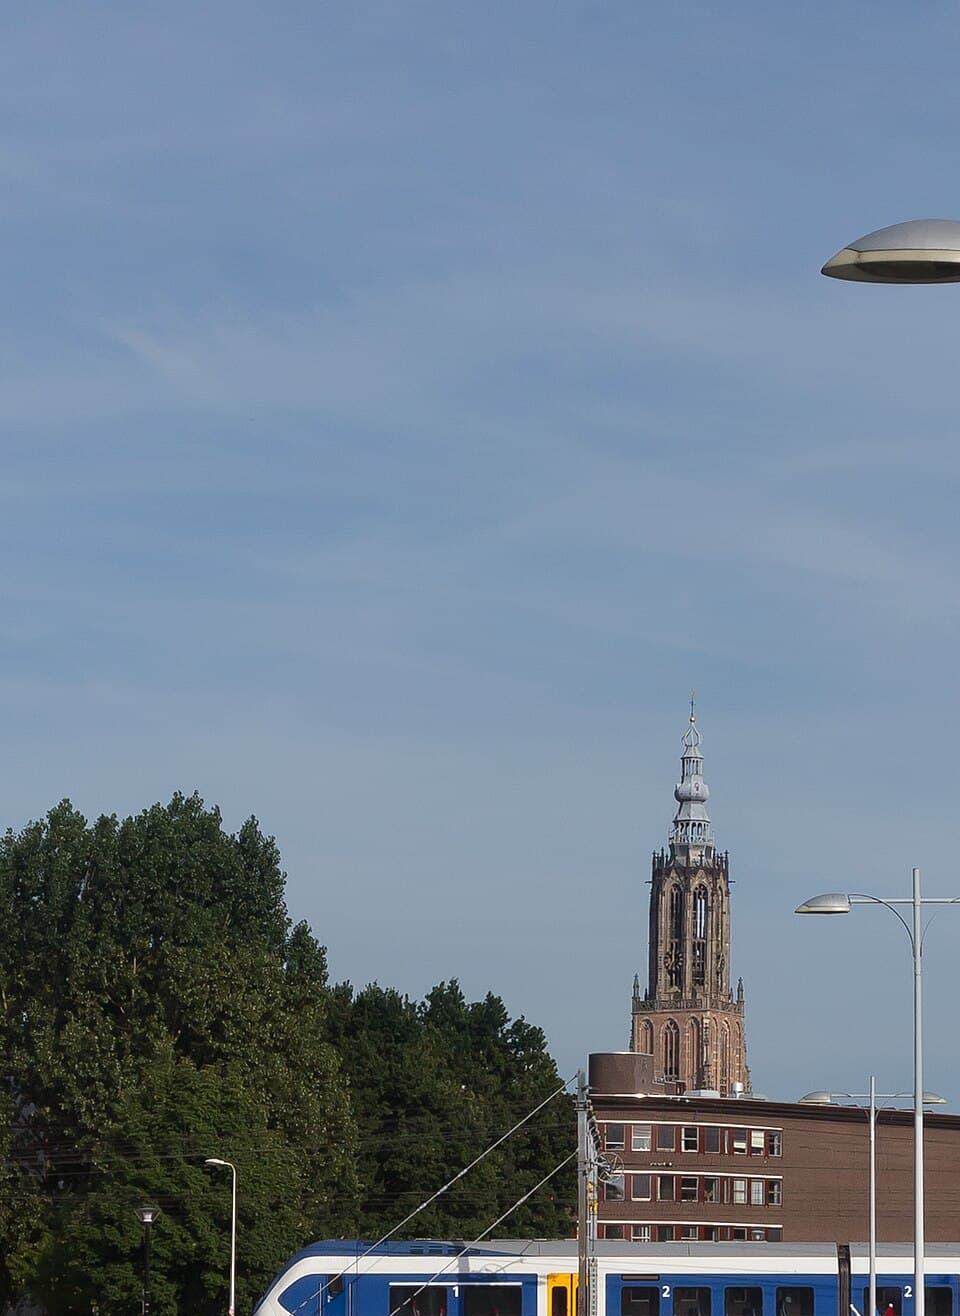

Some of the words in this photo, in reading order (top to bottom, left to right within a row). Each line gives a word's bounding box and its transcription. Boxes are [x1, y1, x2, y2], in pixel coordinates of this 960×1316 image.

[452, 1285, 460, 1298] 1
[661, 1285, 671, 1298] 2
[903, 1285, 913, 1298] 2
